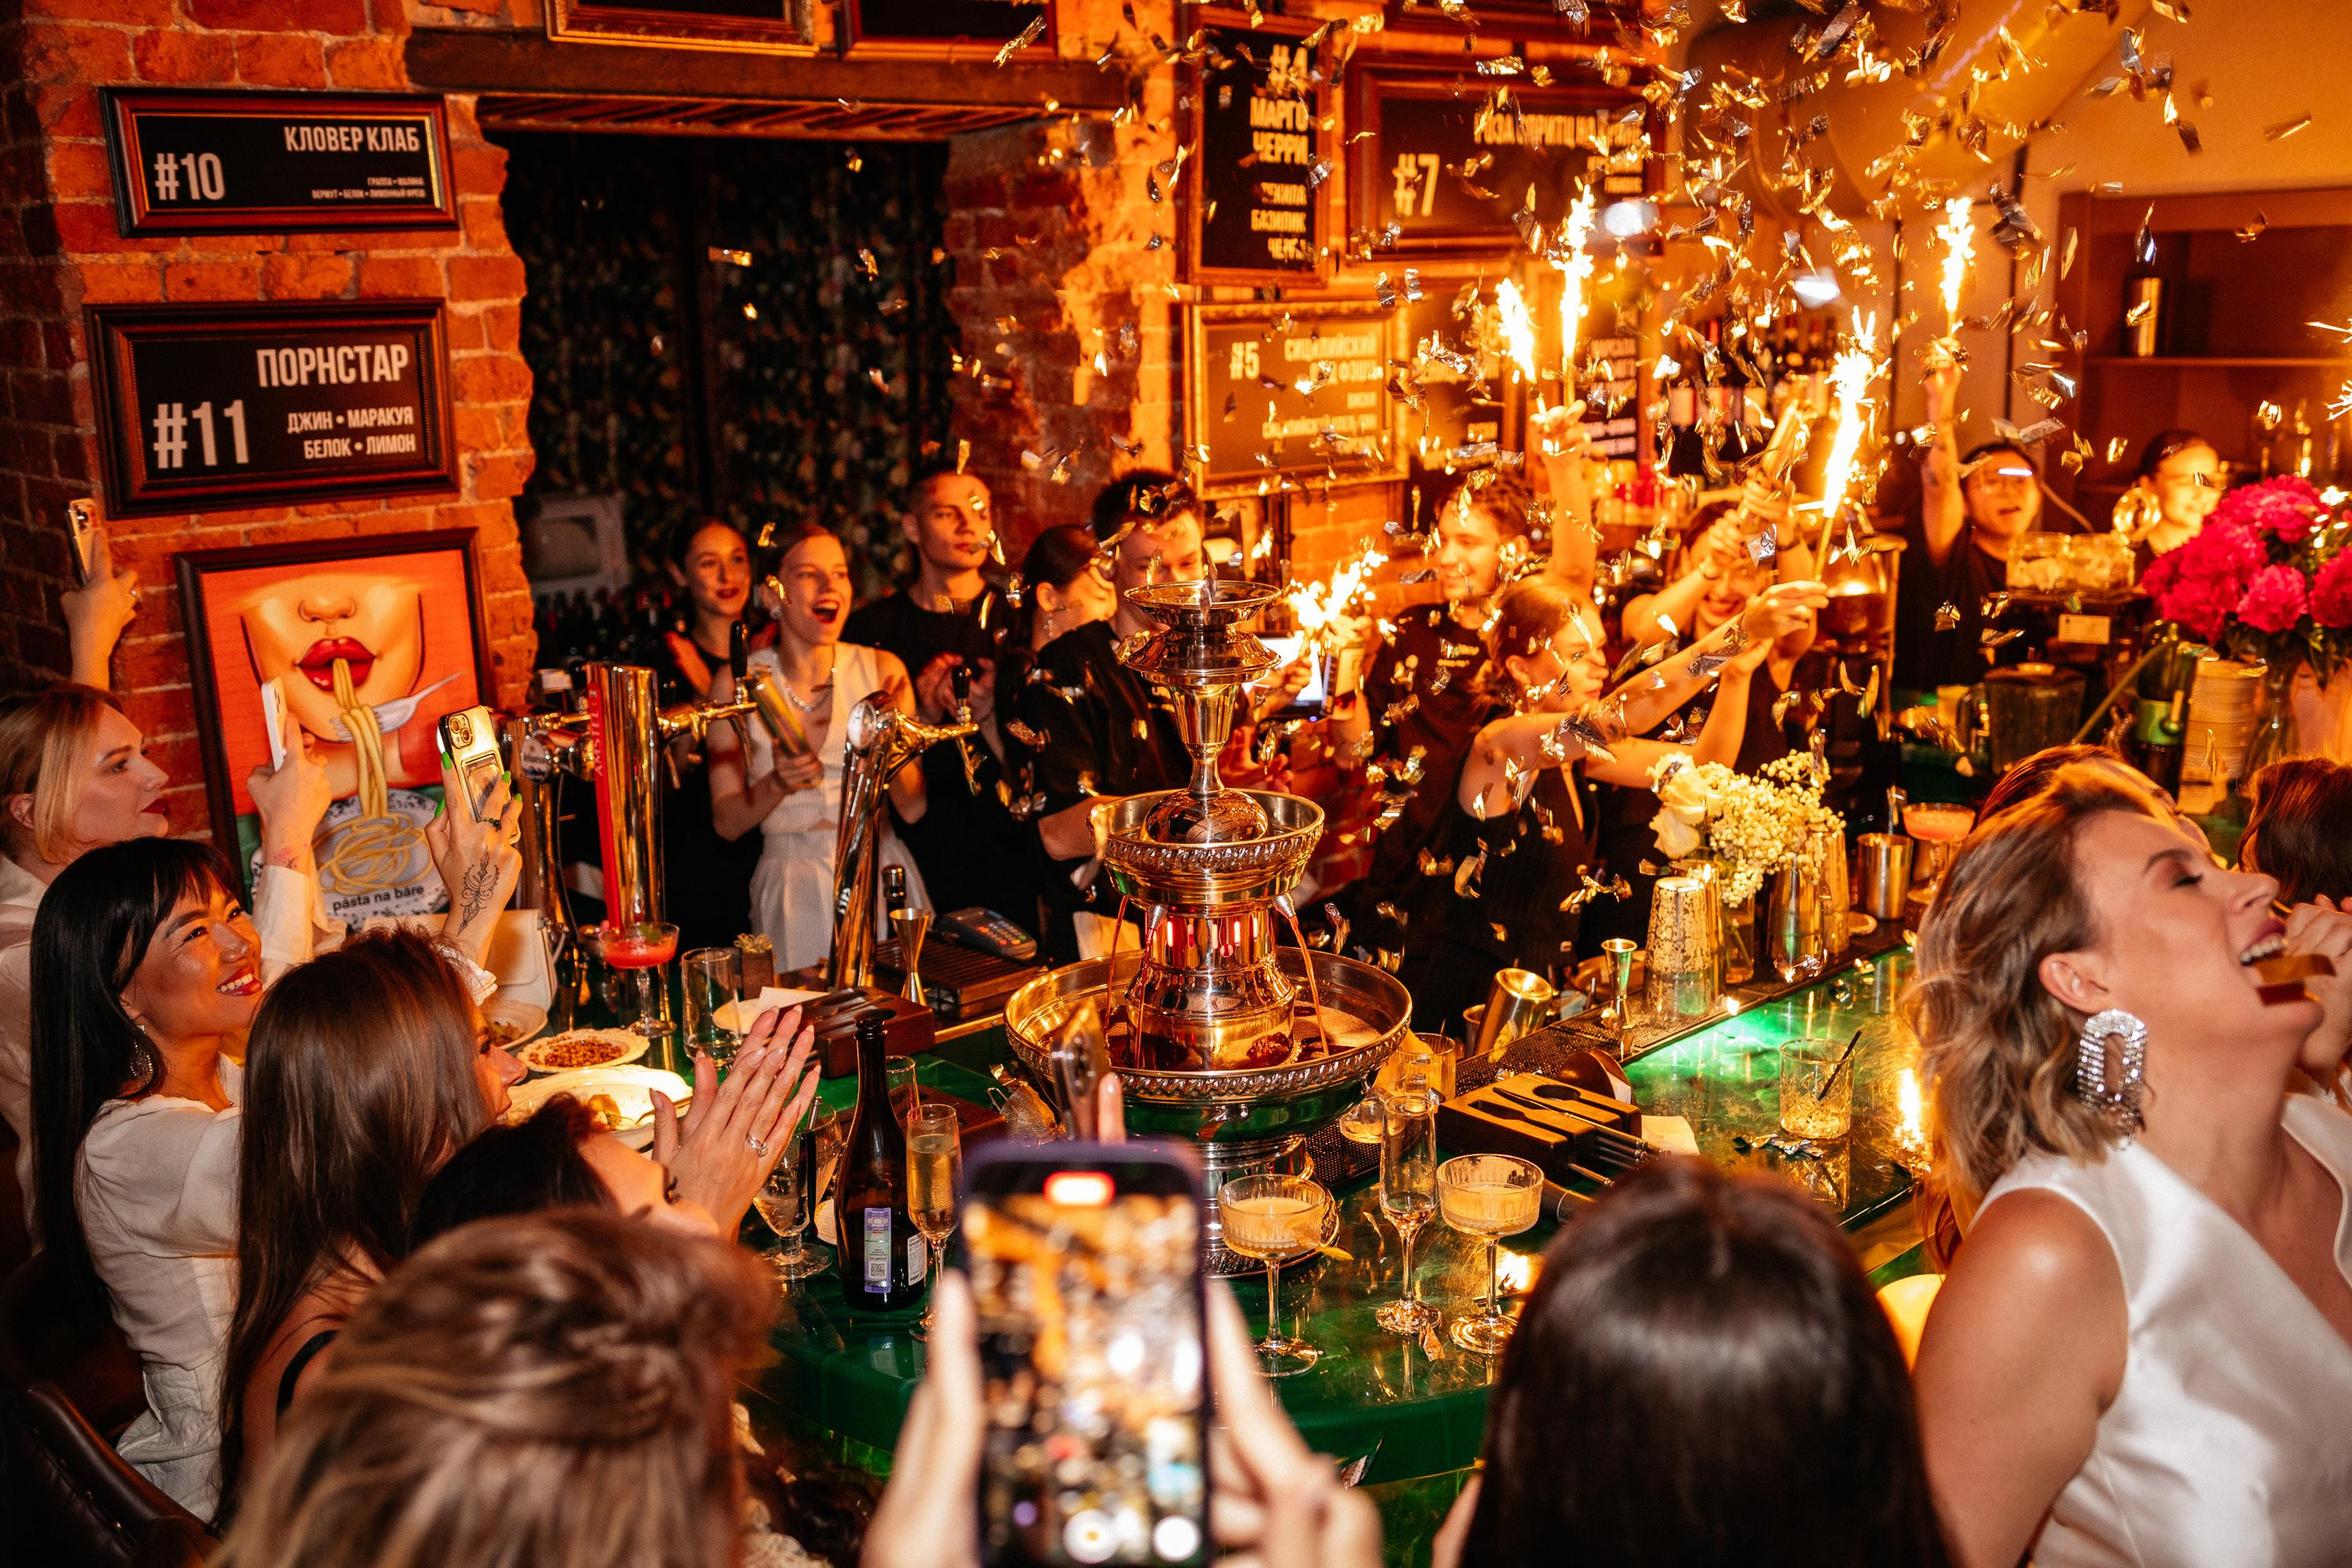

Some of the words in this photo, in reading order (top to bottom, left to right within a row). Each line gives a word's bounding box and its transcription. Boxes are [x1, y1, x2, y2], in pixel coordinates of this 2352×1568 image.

[284, 126, 364, 152] КЛОВЕР
[368, 127, 421, 152] КЛАБ
[1253, 130, 1308, 164] ЧЕРРИ
[154, 152, 226, 201] #10
[1392, 153, 1440, 217] #7
[1250, 209, 1307, 232] БАЗИЛИК
[256, 344, 409, 388] ПОРНСТАР
[1229, 341, 1260, 380] #5
[153, 399, 249, 469] #11
[288, 411, 334, 434] ДЖИН
[347, 406, 413, 429] МАРАКУЯ
[303, 437, 352, 459] БЕЛОК
[366, 434, 416, 456] ЛИМОН
[374, 891, 390, 903] na
